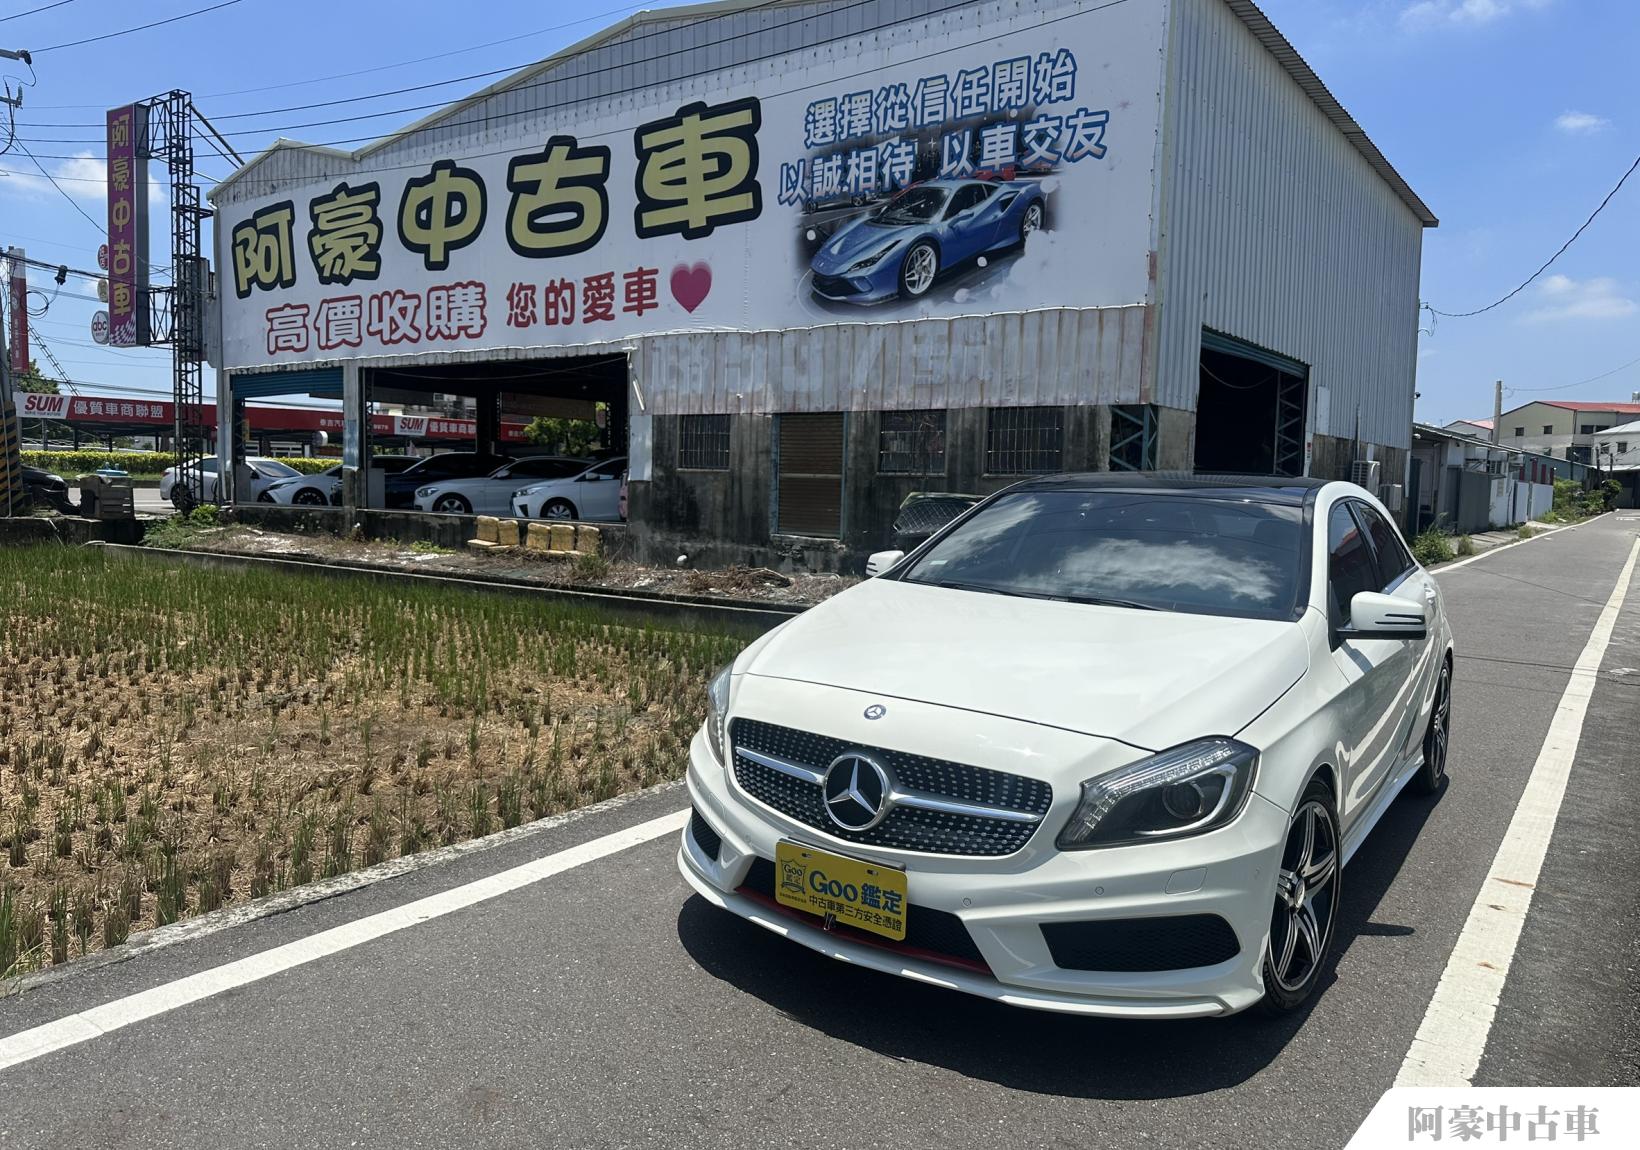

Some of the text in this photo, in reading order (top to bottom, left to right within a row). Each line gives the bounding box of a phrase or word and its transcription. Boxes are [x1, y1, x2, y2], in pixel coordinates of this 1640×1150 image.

[803, 48, 1078, 149] 選擇從信任開始
[777, 107, 1110, 206] 以誠相待 以車交友
[111, 114, 132, 316] 阿豪中古車
[231, 96, 763, 299] 阿豪中古車
[266, 266, 660, 356] 高價收購 您的愛車
[25, 395, 64, 411] SUM
[74, 400, 164, 418] 優質車商聯盟
[400, 417, 424, 430] SUM
[784, 864, 803, 877] Goo
[809, 870, 902, 915] Goo 鑑定
[809, 895, 903, 932] 中古車第三方安全憑證
